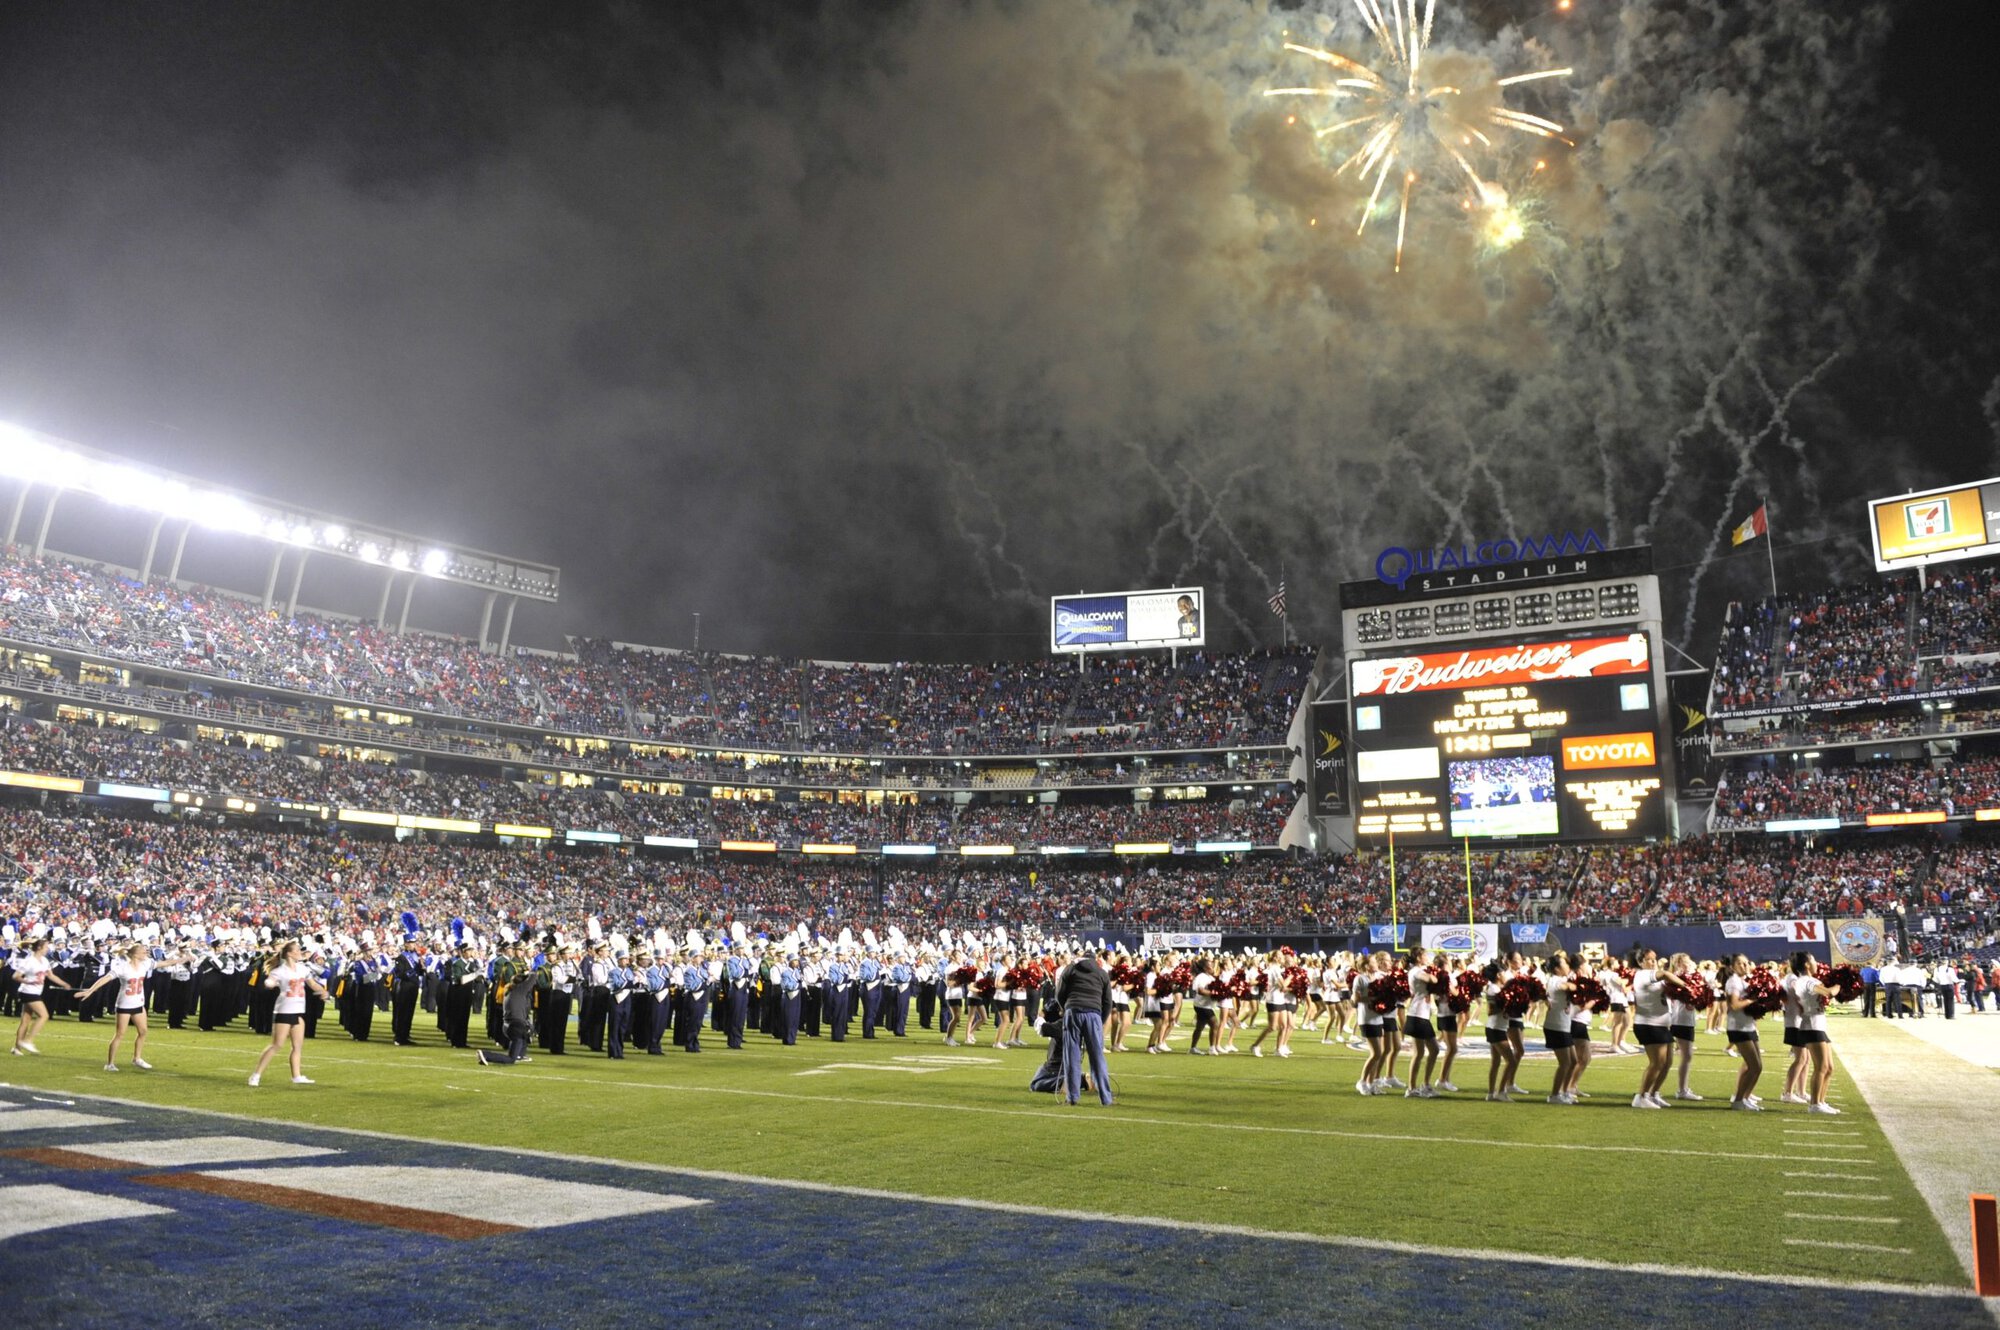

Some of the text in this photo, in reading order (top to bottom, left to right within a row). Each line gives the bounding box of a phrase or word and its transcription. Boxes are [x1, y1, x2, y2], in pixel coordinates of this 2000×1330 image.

[1375, 528, 1605, 591] QUALCOMM
[1423, 561, 1587, 589] STADIUM
[1058, 611, 1124, 627] QUALCOMM
[1377, 642, 1573, 694] Budweiser
[1675, 734, 1712, 748] Sprint
[1567, 742, 1650, 762] TOYOTA
[1315, 757, 1345, 770] Sprint
[1465, 929, 1479, 940] LIE
[1794, 921, 1817, 940] N
[1150, 933, 1166, 949] A
